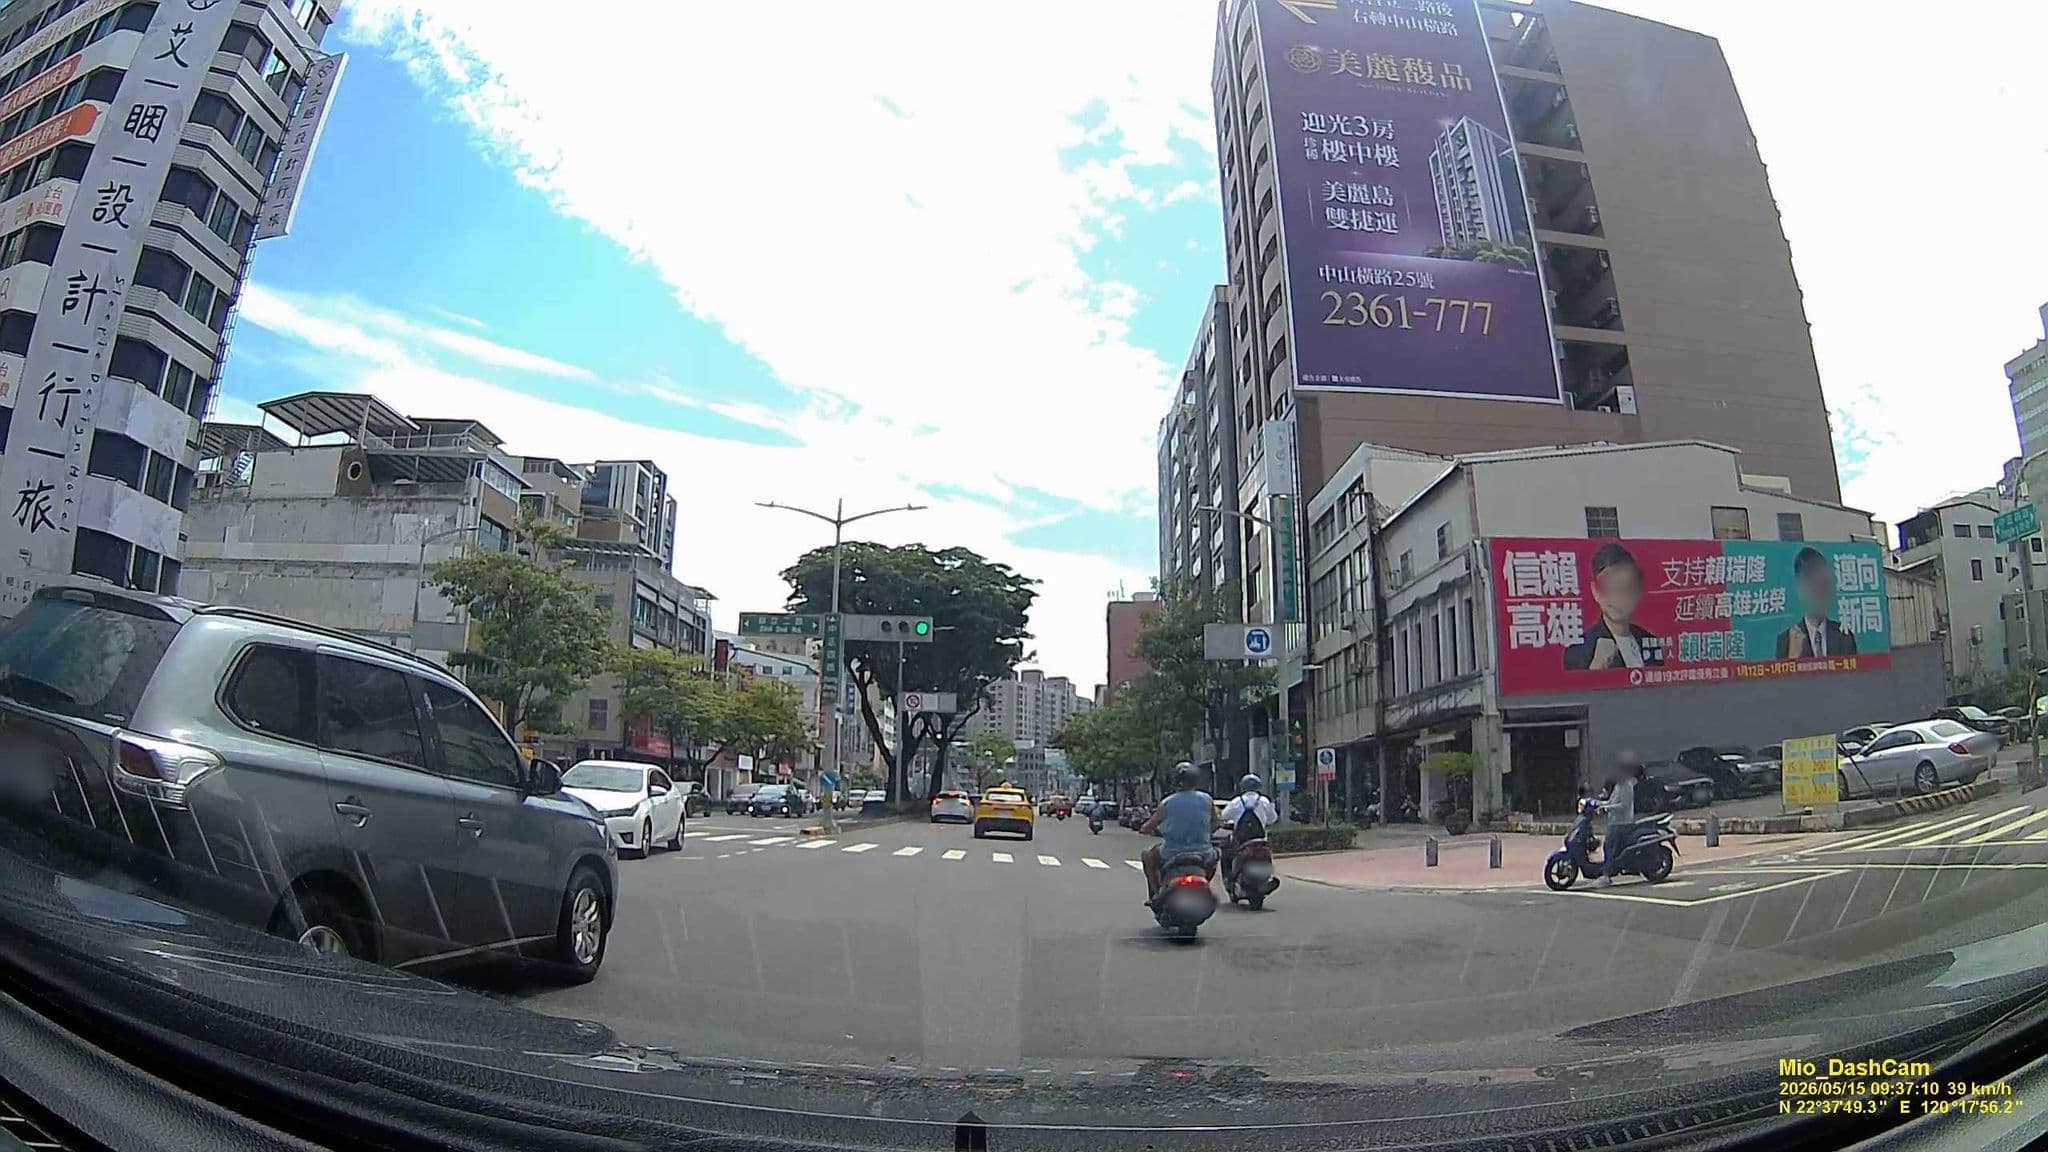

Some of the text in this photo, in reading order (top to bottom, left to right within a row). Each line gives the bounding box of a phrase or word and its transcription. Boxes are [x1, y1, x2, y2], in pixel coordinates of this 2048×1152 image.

[1328, 48, 1473, 92] 美麗馥品
[1301, 111, 1395, 141] 迎光3房
[1321, 141, 1401, 169] 樓中樓
[1321, 179, 1395, 208] 美麗島
[1325, 206, 1400, 235] 雙捷運
[1318, 264, 1435, 290] 中山橫路25號
[1320, 290, 1493, 336] 2361-777
[1503, 550, 1580, 598] 信賴
[1660, 555, 1766, 588] 支持賴瑞隆
[1833, 553, 1879, 592] 邁向
[1674, 588, 1787, 622] 延續高雄光榮
[1837, 596, 1883, 634] 新局
[1508, 602, 1585, 650] 高雄
[1678, 631, 1746, 662] 賴瑞隆
